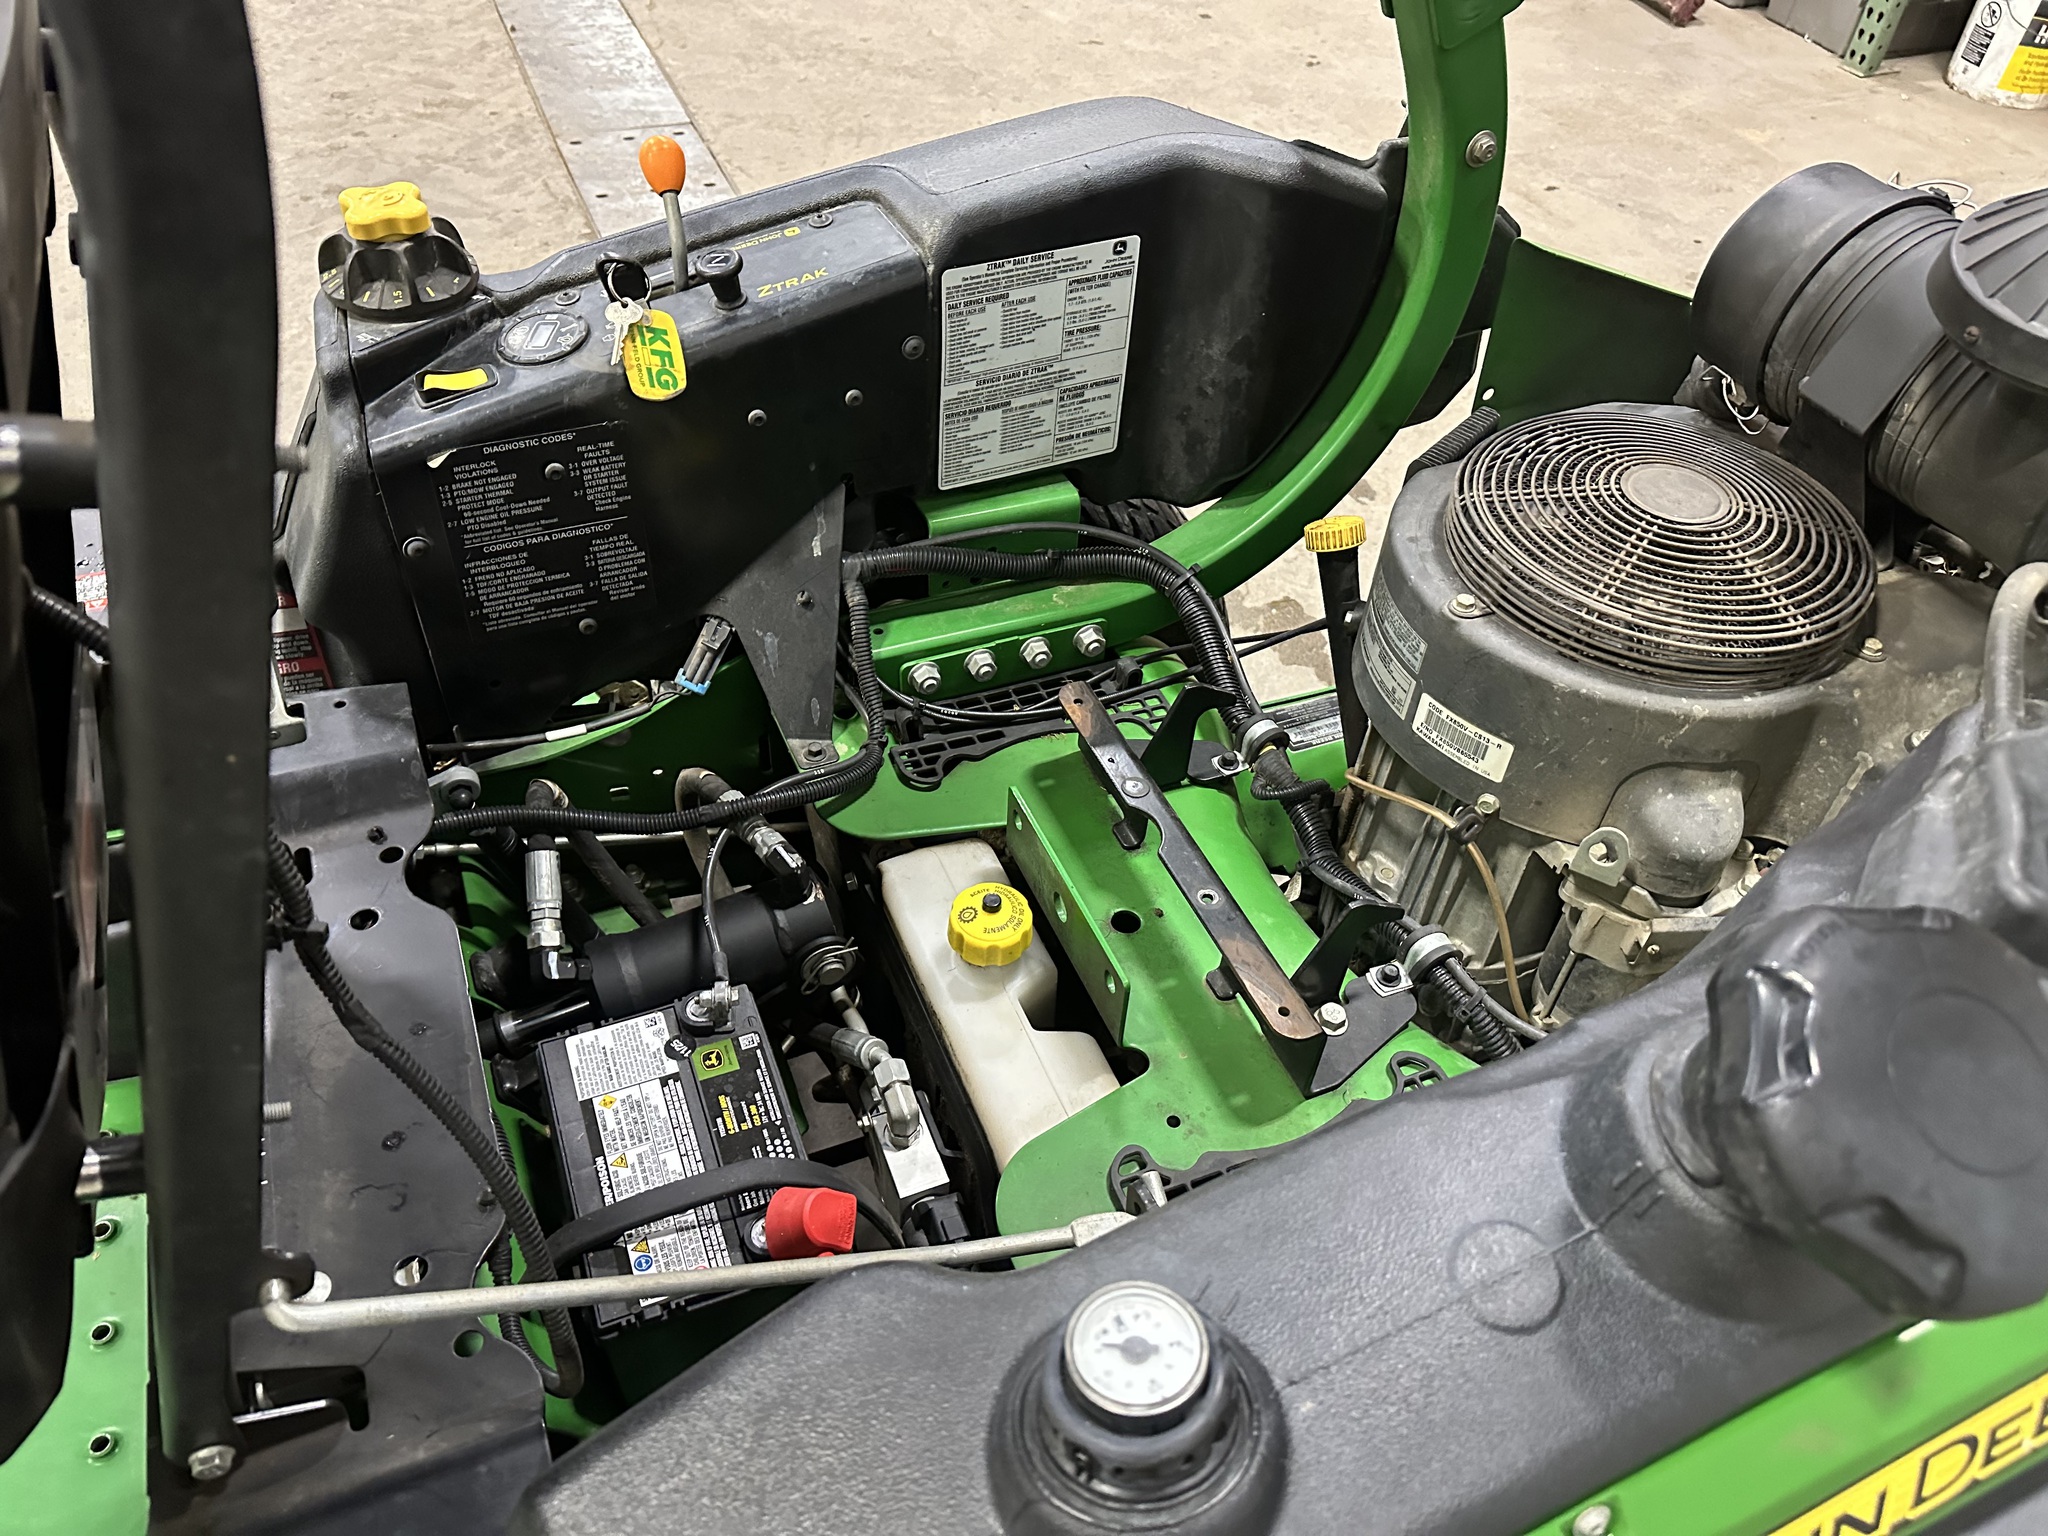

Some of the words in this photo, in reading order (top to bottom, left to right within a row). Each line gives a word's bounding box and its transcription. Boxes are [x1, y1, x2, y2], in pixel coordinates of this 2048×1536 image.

[987, 260, 1012, 272] ZTRAK™
[1013, 256, 1029, 267] DAILY
[1031, 252, 1055, 264] SERVICE
[757, 267, 829, 299] ZTRAK
[1068, 275, 1097, 287] APPROXIMATE
[1098, 273, 1109, 281] FLUID
[1110, 269, 1133, 280] CAPACITIES
[1068, 287, 1079, 296] (WITH
[1080, 284, 1094, 294] FILTER
[1094, 281, 1112, 292] CHANGE)
[393, 290, 404, 305] 1.5
[948, 301, 963, 311] DAILY
[963, 298, 985, 308] SERVICE
[985, 292, 1010, 305] REQUIRED
[948, 311, 965, 320] BEFORE
[966, 308, 978, 316] EACH
[978, 306, 987, 314] USE
[1065, 328, 1075, 338] TIRE
[1076, 324, 1102, 336] PRESSURE:
[646, 326, 680, 391] KFG
[636, 363, 646, 388] GROUP
[976, 376, 1002, 388] SERVICIO
[1002, 372, 1021, 381] DIARIO
[1022, 370, 1030, 378] DE
[1031, 364, 1054, 375] ZTRAK™
[1060, 384, 1089, 395] CAPACIDADES
[1090, 377, 1120, 388] APROXIMADAS
[1060, 395, 1066, 403] DE
[1066, 391, 1086, 402] FLUIDOS
[945, 410, 968, 421] SERVICIO
[968, 406, 985, 415] DIARIO
[985, 400, 1012, 412] REQUERIDO
[1056, 434, 1075, 444] PRESIÓN
[1082, 426, 1112, 438] NEUMÁTICOS:
[483, 438, 539, 454] DIAGNOSTIC
[577, 441, 614, 452] REAL-TIME
[584, 449, 610, 458] FAULTS
[453, 460, 496, 472] INTERLOCK
[568, 462, 578, 470] 3-1
[581, 459, 598, 467] OVER
[598, 454, 624, 464] VOLTAGE
[454, 467, 498, 480] VIOLATIONS
[570, 469, 580, 477] 3-3
[582, 466, 600, 474] WEAK
[600, 462, 626, 471] BATTERY
[593, 470, 619, 479] STARTER
[438, 485, 450, 493] 1-2
[451, 481, 472, 490] BRAKE
[473, 478, 486, 486] NOT
[487, 473, 517, 483] ENGAGED
[584, 478, 608, 487] SYSTEM
[609, 474, 626, 483] ISSUE
[440, 492, 451, 500] 1-3
[485, 481, 514, 491] ENGAGED
[573, 489, 583, 497] 3-7
[586, 485, 609, 494] OUTPUT
[610, 481, 628, 490] FAULT
[586, 490, 616, 501] DETECTED
[441, 499, 453, 507] 2-5
[455, 494, 483, 504] STARTER
[484, 489, 513, 499] THERMAL
[457, 501, 485, 511] PROTECT
[486, 497, 504, 506] MODE
[594, 498, 612, 506] Check
[612, 495, 632, 503] Engine
[463, 507, 494, 517] 60-second
[495, 502, 527, 512] Cool-Down
[528, 496, 550, 506] Needed
[595, 504, 619, 512] Harness
[446, 520, 458, 528] 2-7
[460, 518, 475, 526] LOW
[476, 513, 498, 522] ENGINE
[511, 505, 543, 516] PRESSURE
[480, 519, 507, 529] Disabled
[483, 539, 524, 553] CODIGOS
[526, 535, 550, 545] PARA
[589, 543, 615, 552] TIEMPO
[592, 536, 618, 545] FALLAS
[596, 545, 638, 558] SOBREVOLTAJE
[464, 554, 517, 568] INFRACCIONES
[470, 559, 526, 574] INTERBLOQUEO
[603, 560, 633, 570] PROBLEMA
[474, 573, 495, 582] FRENO
[506, 565, 535, 576] APLICADO
[599, 566, 638, 578] ARRANCADOR
[601, 576, 619, 584] FALLA
[628, 570, 648, 579] SALIDA
[601, 580, 633, 591] DETECTADA
[489, 587, 529, 599] ARRANCADOR
[1420, 722, 1434, 736] E/NO
[1428, 702, 1444, 716] CODE
[1446, 714, 1503, 750] FX850V-CS13-R
[1416, 727, 1445, 751] KAWASAKI
[1445, 748, 1471, 766] ASSEMBLED
[1481, 769, 1491, 778] USA
[970, 888, 991, 898] ACEITE
[1013, 918, 1024, 933] ONLY
[670, 1039, 692, 1058] 11/25
[718, 1095, 728, 1109] MOIS
[749, 1104, 758, 1115] 300
[598, 1110, 608, 1133] IMMEDIATELY
[723, 1110, 735, 1134] 6-MONTH
[740, 1122, 749, 1130] U1
[752, 1114, 762, 1126] CCA
[603, 1132, 611, 1143] EYES
[605, 1142, 613, 1155] FLUSH
[594, 1156, 617, 1206] ER/POISON
